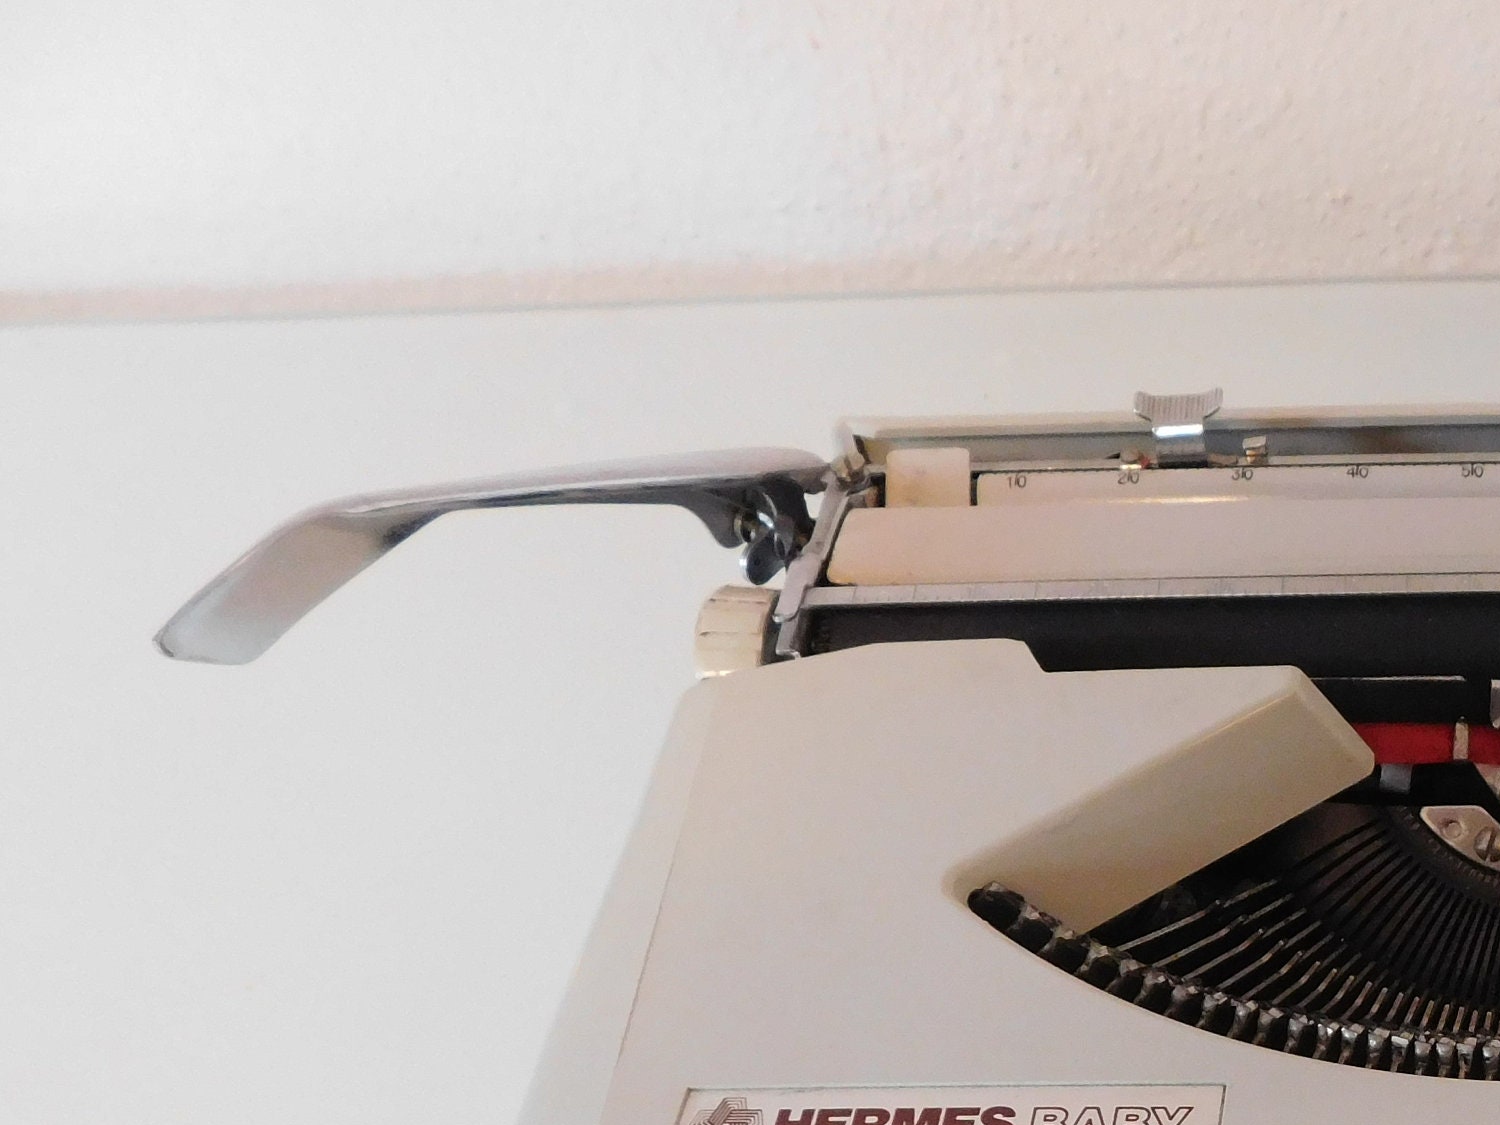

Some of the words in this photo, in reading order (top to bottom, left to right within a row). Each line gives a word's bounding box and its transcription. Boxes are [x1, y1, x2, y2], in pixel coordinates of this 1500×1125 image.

[1117, 472, 1141, 486] 20
[1231, 467, 1254, 482] 30
[1346, 466, 1369, 479] 40
[1461, 465, 1484, 479] 50
